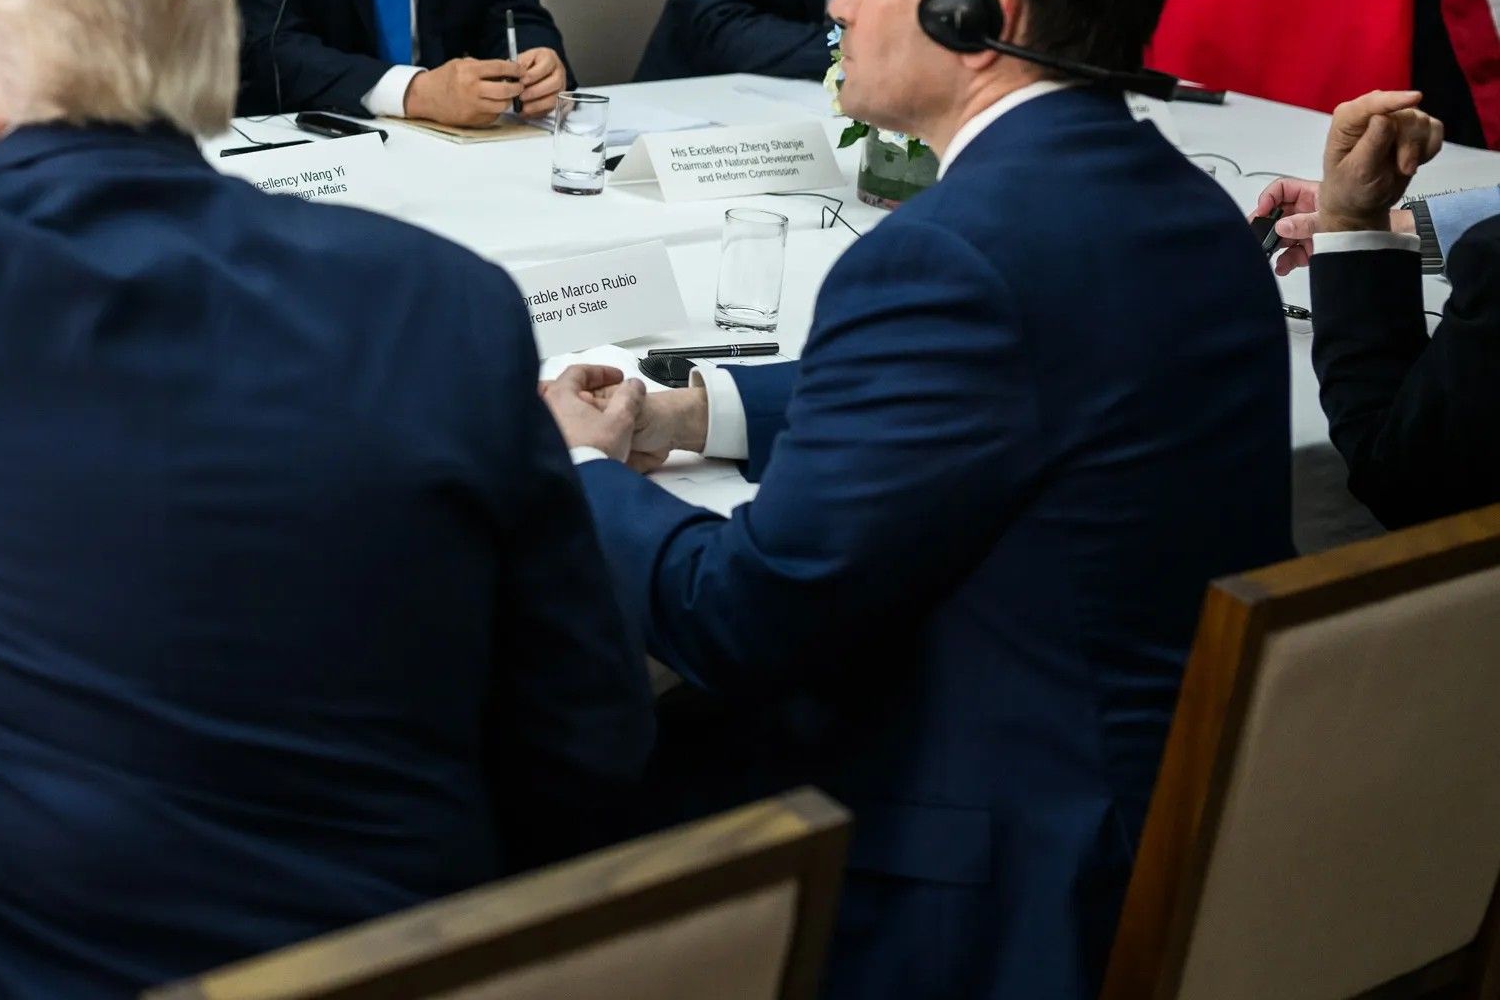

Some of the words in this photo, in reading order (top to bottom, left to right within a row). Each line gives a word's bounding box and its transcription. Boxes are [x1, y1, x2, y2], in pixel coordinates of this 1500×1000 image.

[671, 147, 688, 158] His
[689, 144, 738, 156] Excellency
[740, 141, 770, 153] Zheng
[770, 138, 805, 151] Shanjie
[671, 161, 714, 172] Chairman
[715, 158, 723, 168] of
[724, 156, 760, 168] National
[760, 152, 815, 164] Development
[300, 169, 332, 182] Wang
[334, 165, 345, 177] Yi
[698, 172, 715, 183] and
[716, 169, 748, 181] Reform
[749, 167, 800, 179] Commission
[317, 183, 348, 196] Affairs
[561, 281, 600, 299] Marco
[601, 273, 638, 291] Rubio
[530, 308, 563, 325] retary
[565, 303, 578, 317] of
[578, 298, 609, 315] State
